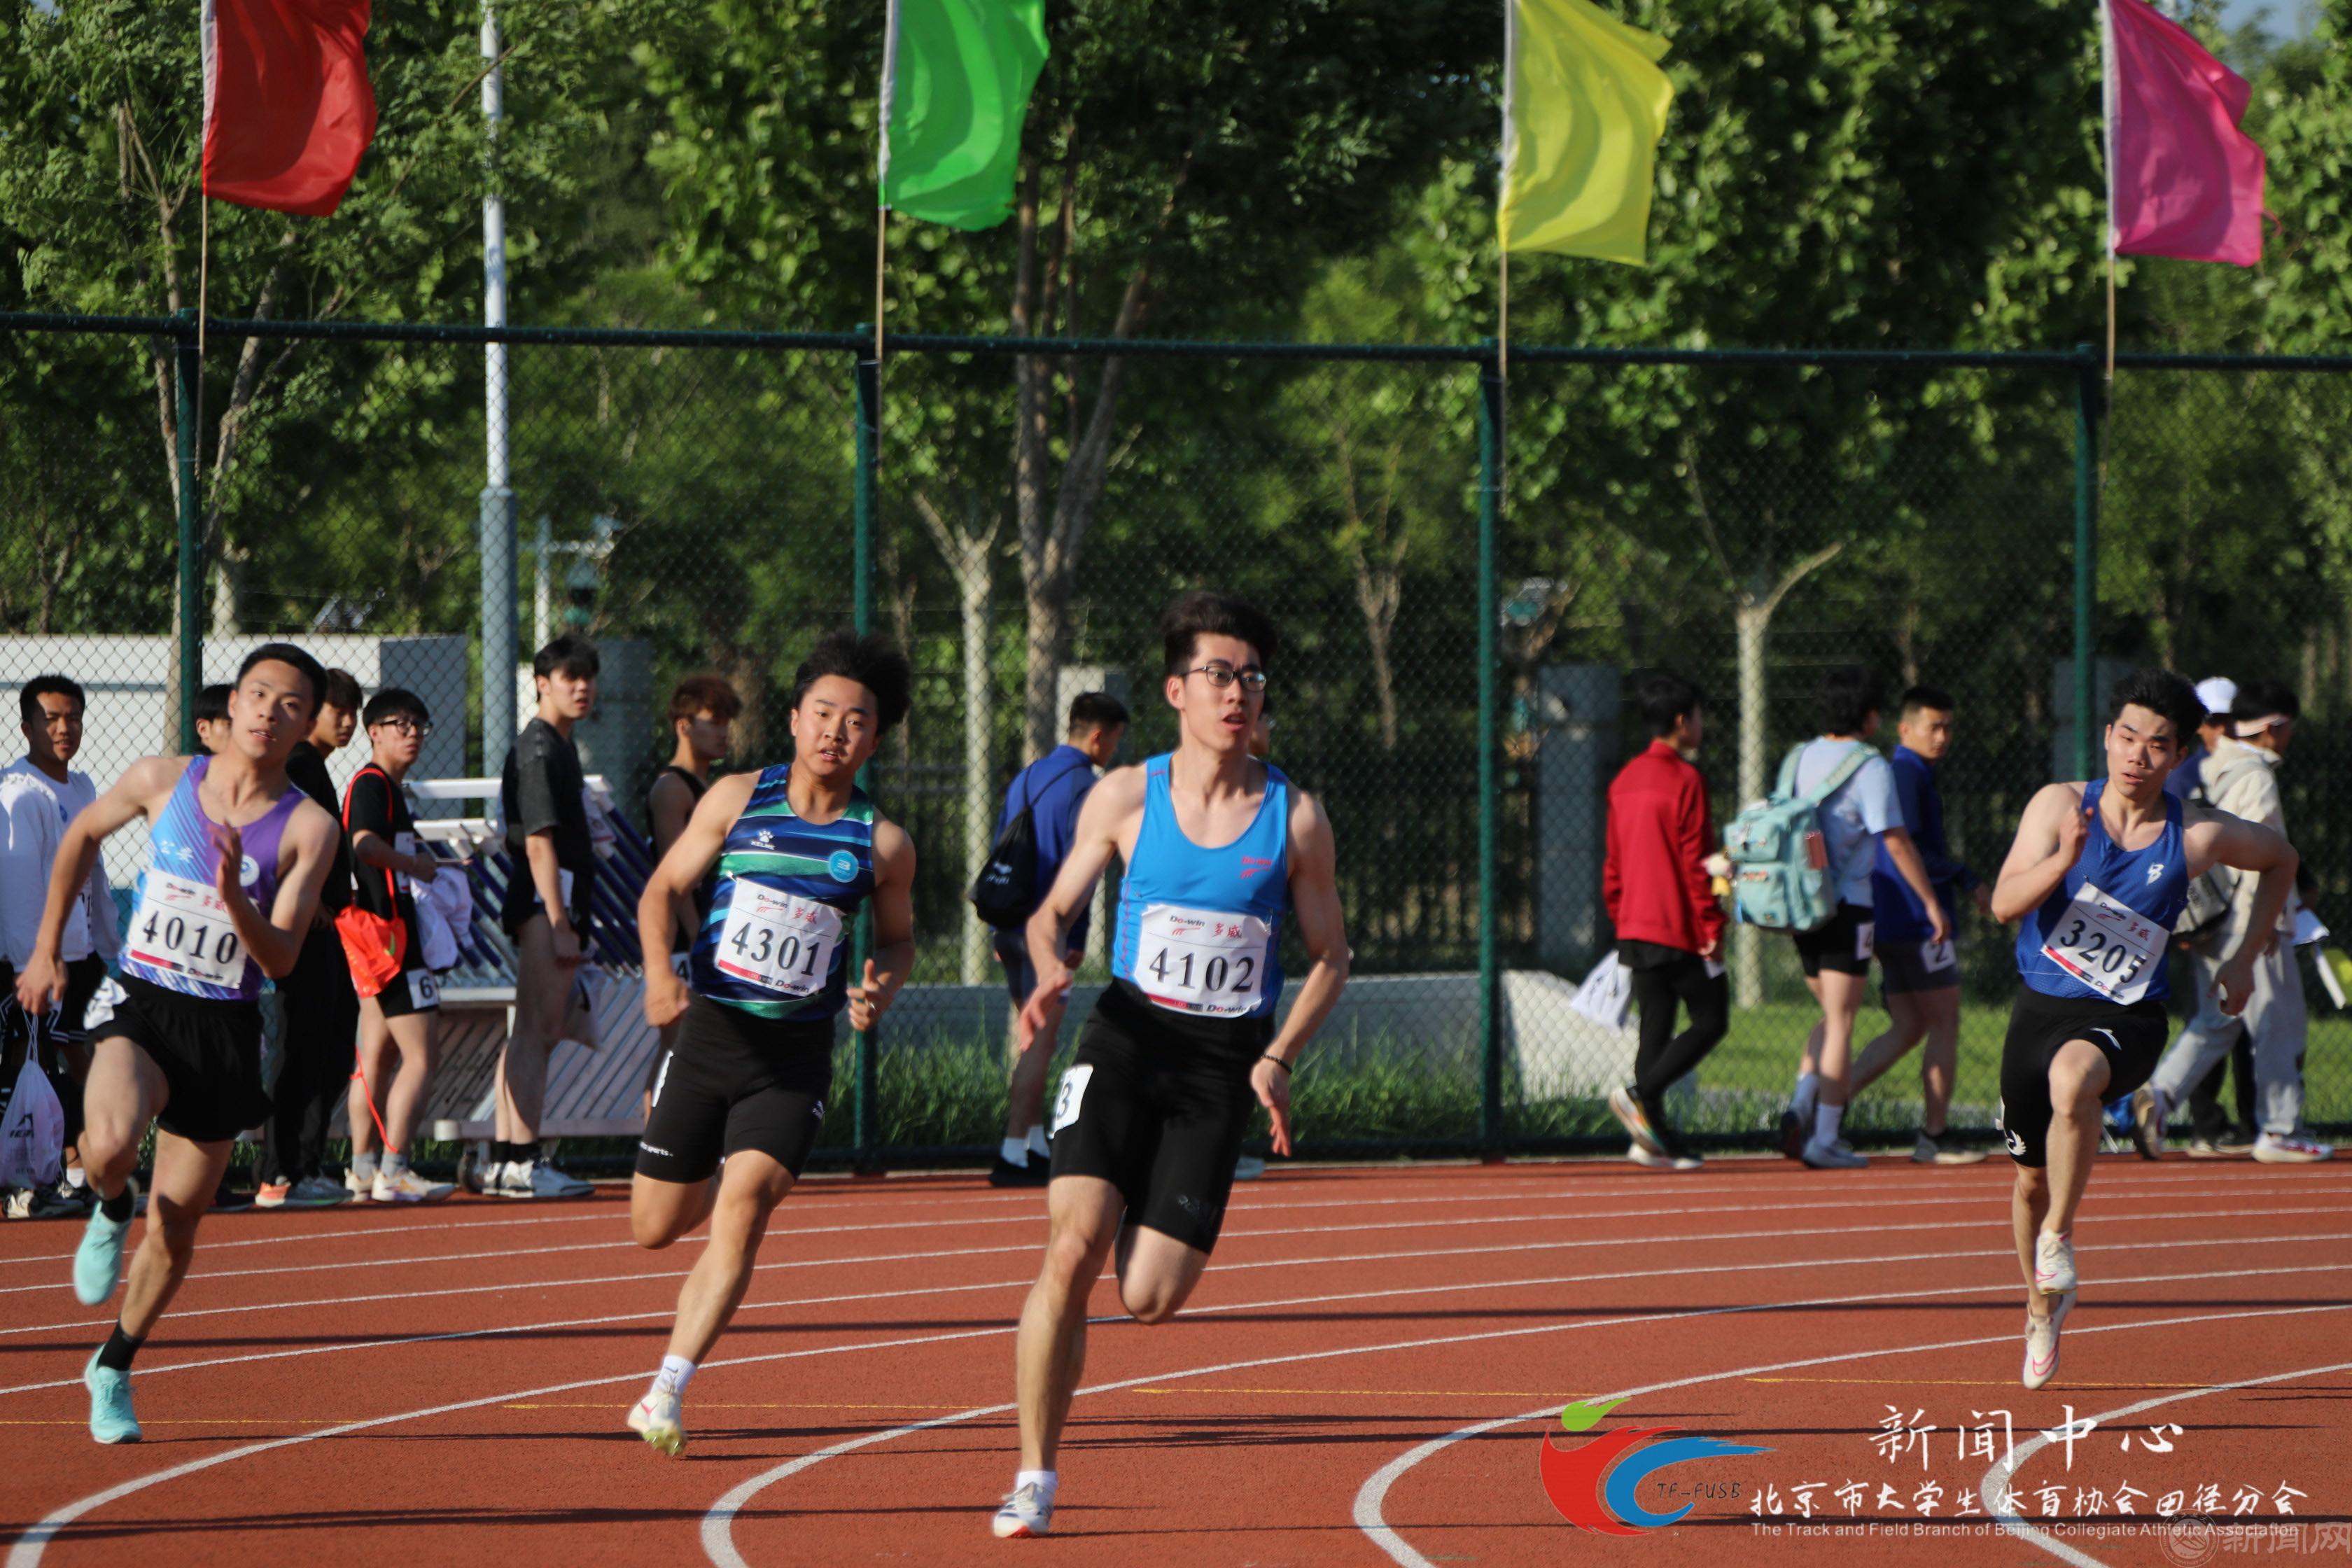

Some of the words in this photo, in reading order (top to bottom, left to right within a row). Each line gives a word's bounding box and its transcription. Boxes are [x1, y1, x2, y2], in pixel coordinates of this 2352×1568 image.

[757, 893, 788, 909] Do-win
[1169, 915, 1205, 927] Do-win
[1210, 921, 1243, 939] 多威
[143, 909, 239, 965] 4010
[731, 921, 820, 977] 4301
[2059, 919, 2148, 983] 3205
[1148, 946, 1255, 993] 4102
[419, 976, 433, 999] 6
[775, 979, 810, 993] Do-win
[1056, 1082, 1073, 1119] 3
